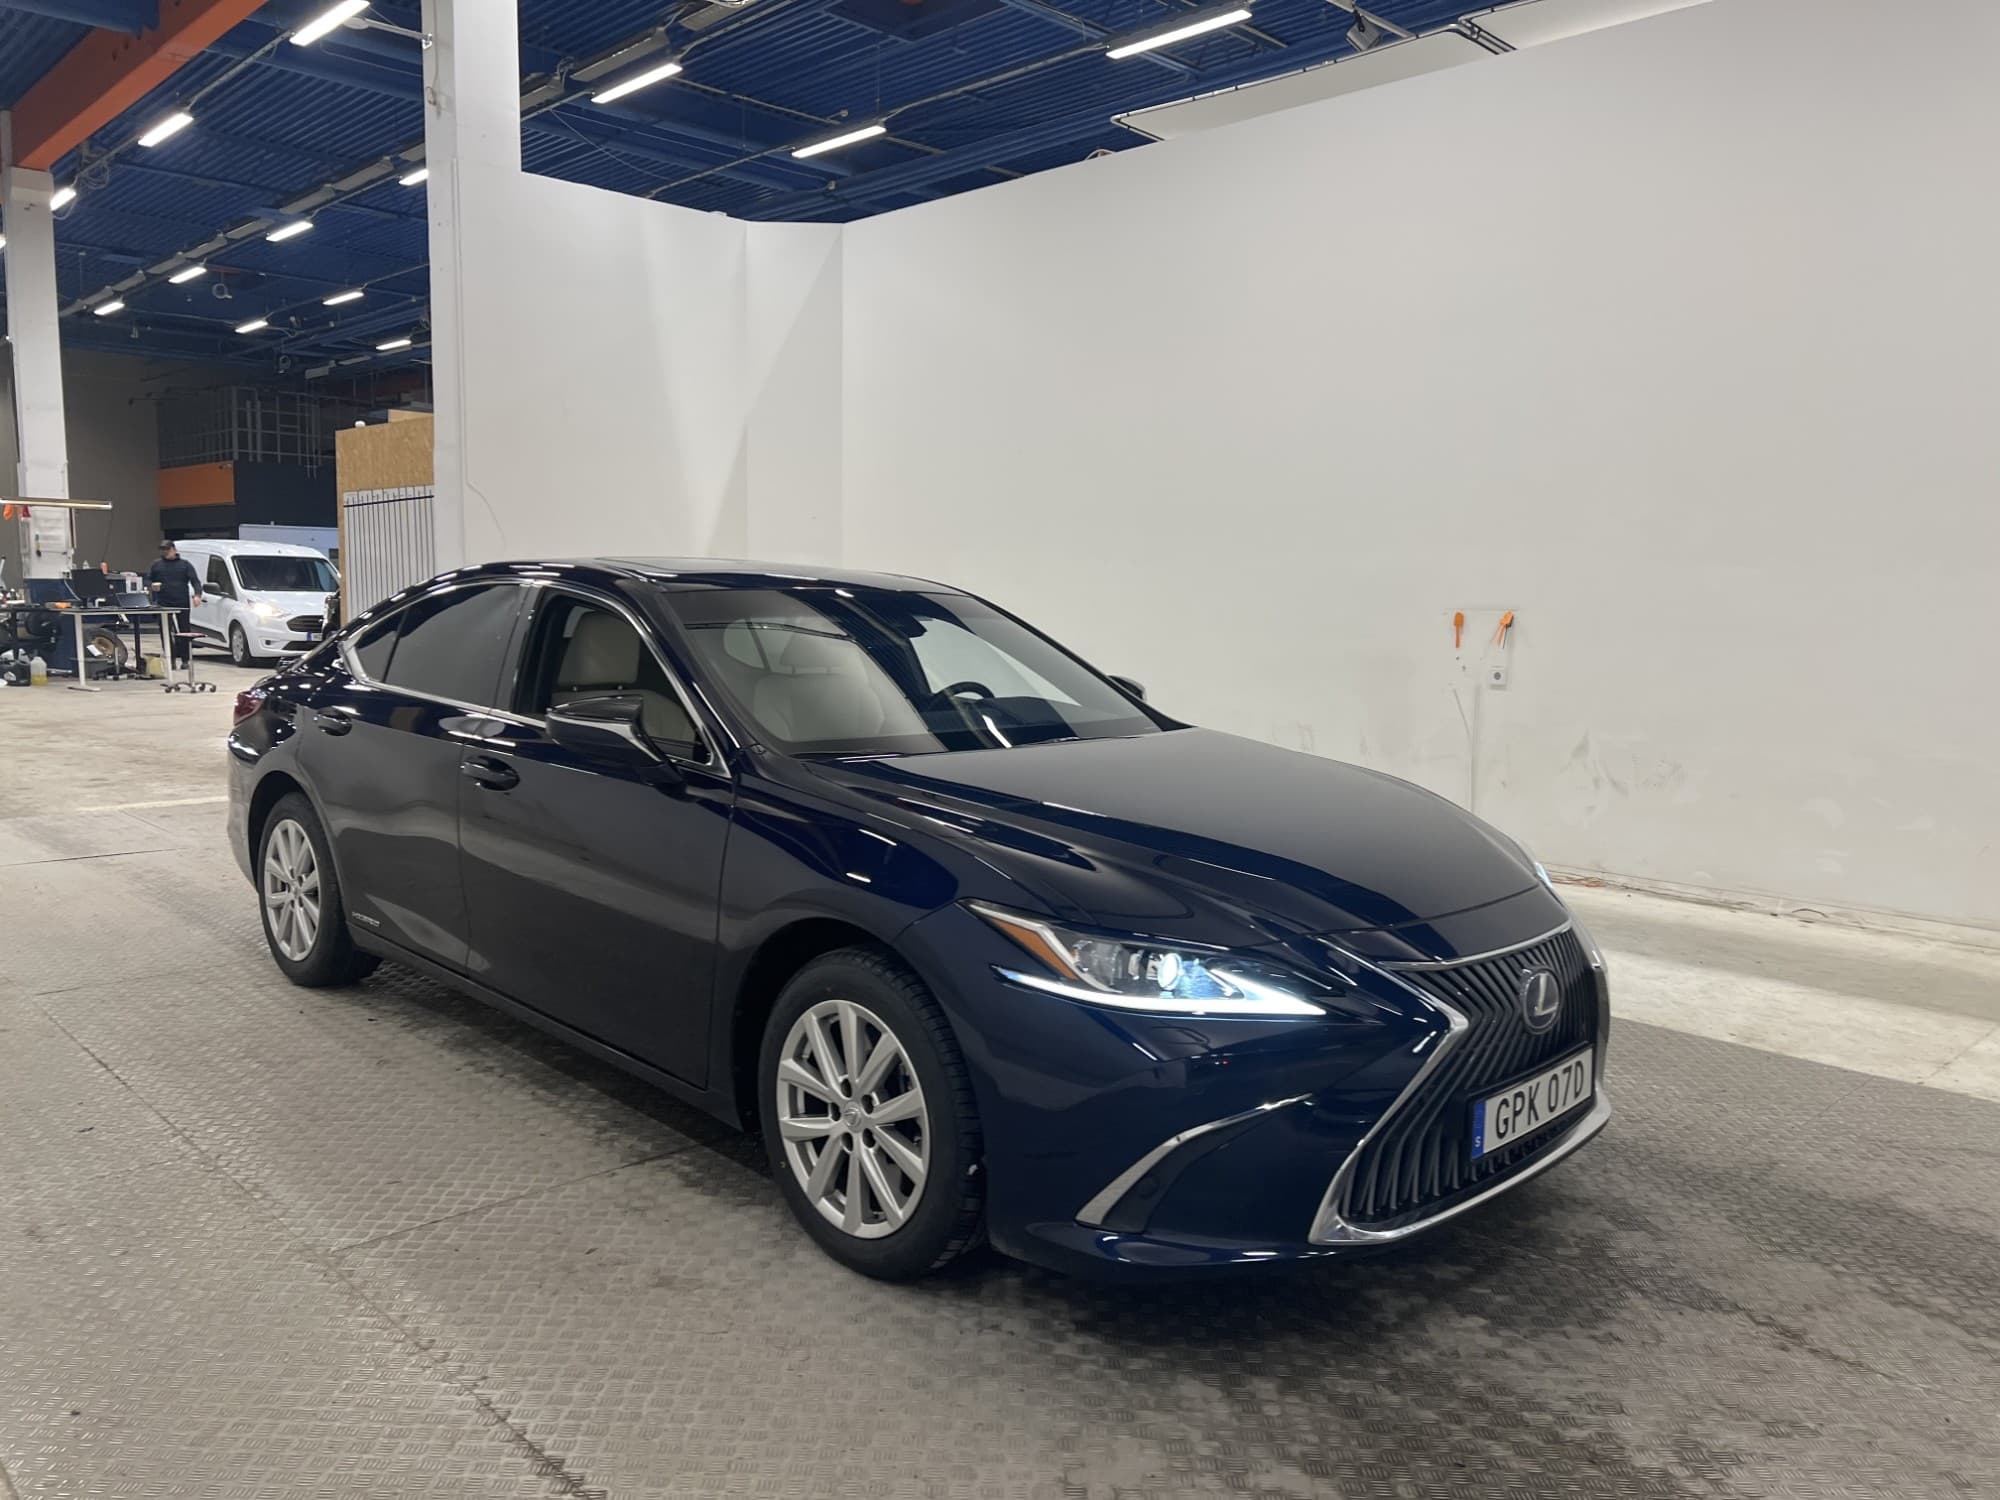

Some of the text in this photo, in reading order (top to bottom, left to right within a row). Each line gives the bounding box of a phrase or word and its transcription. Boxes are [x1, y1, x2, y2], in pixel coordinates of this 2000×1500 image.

[1496, 1060, 1584, 1139] GPK 07D
[1474, 1136, 1481, 1148] S
